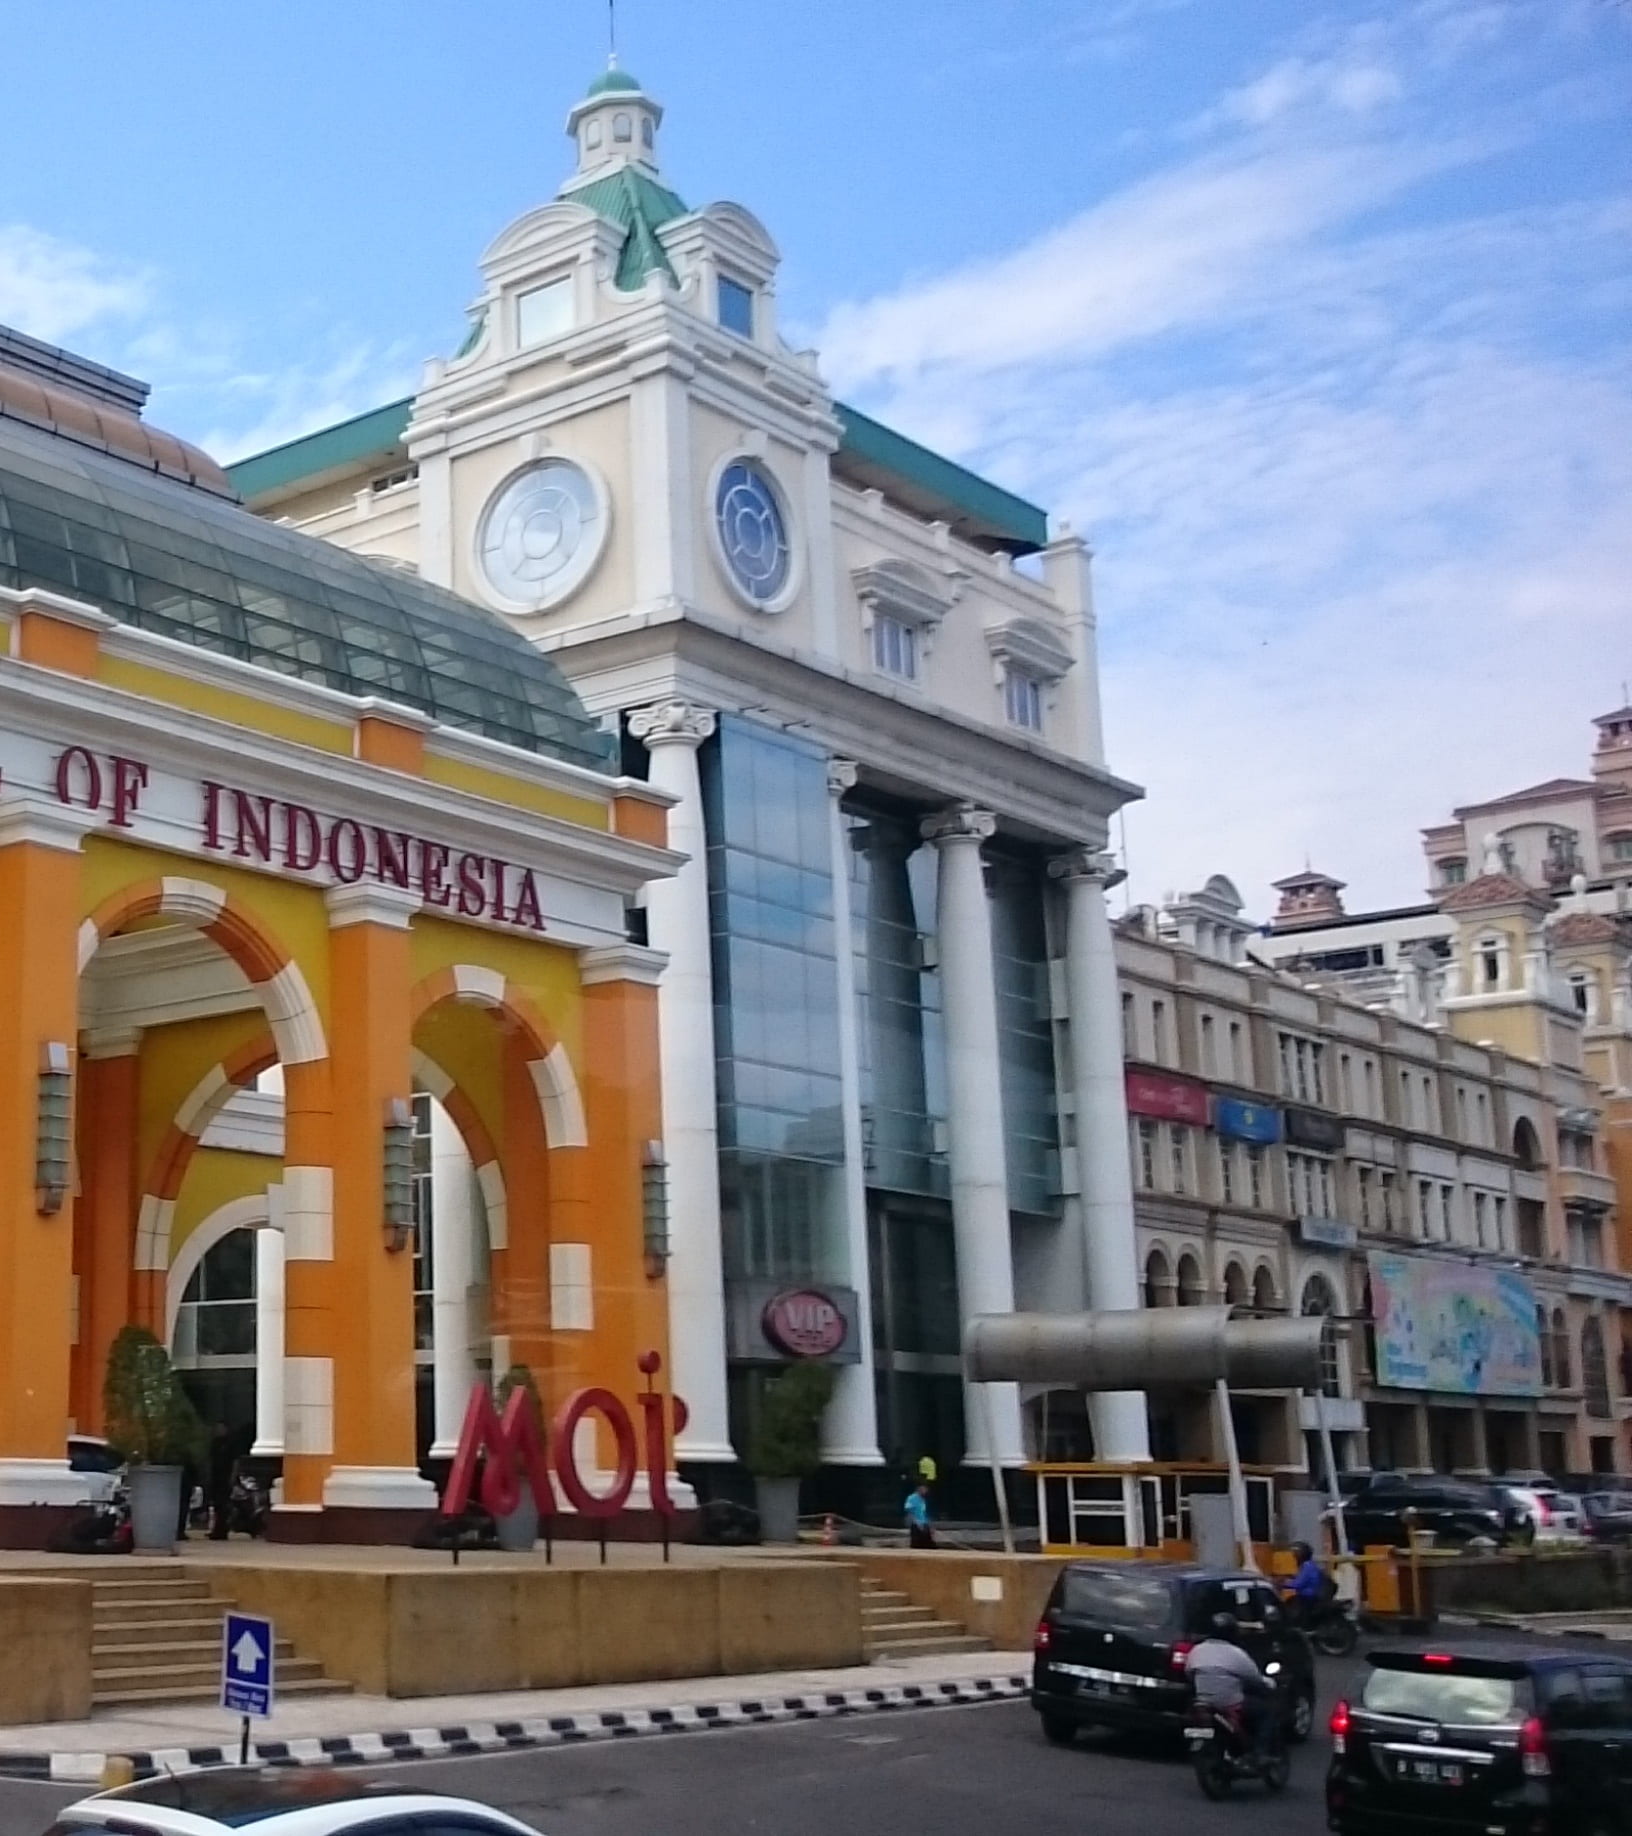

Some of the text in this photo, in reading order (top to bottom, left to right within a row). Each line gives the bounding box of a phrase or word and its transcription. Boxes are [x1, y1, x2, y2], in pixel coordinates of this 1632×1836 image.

[55, 744, 149, 829] OF
[202, 779, 547, 932] INDONESIA
[785, 1302, 835, 1333] VIP
